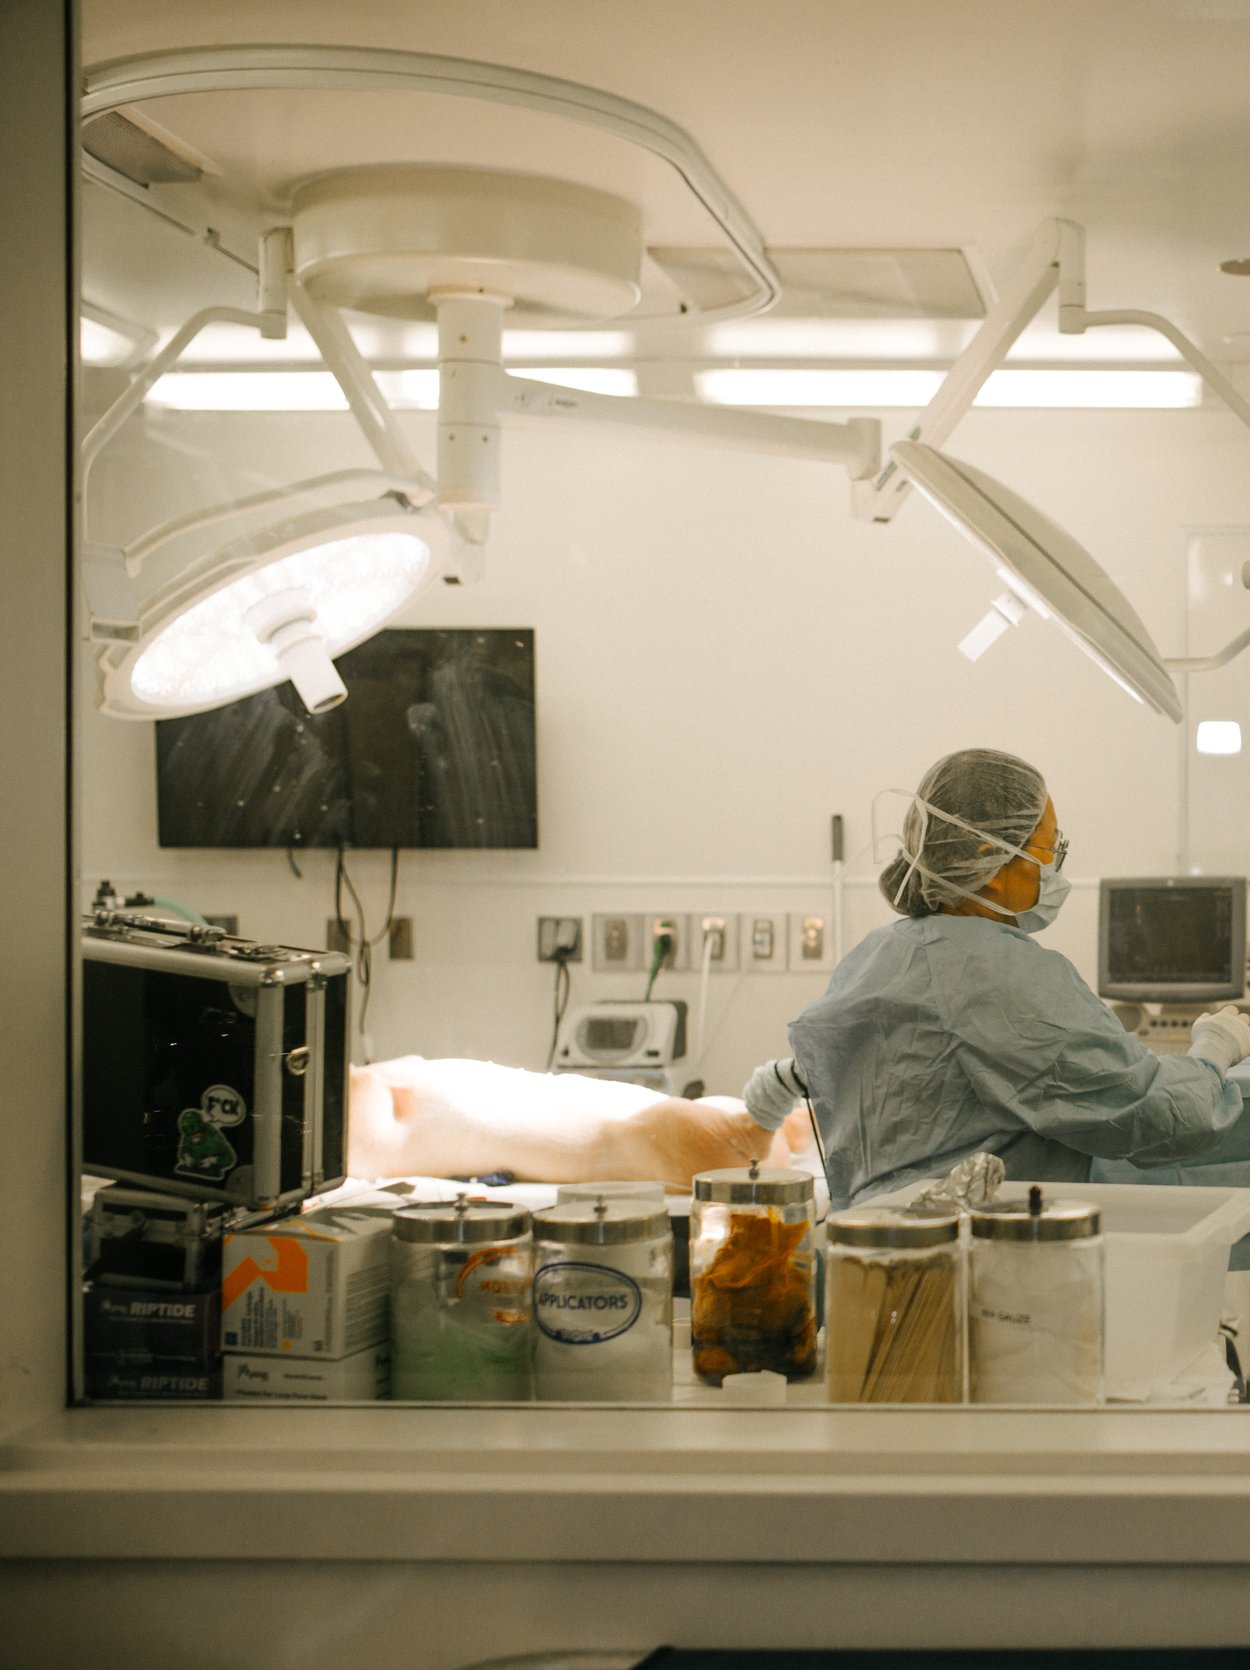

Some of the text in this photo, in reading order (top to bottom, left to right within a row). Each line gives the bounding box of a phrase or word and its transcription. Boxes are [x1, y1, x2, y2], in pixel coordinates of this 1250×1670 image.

[130, 1301, 196, 1317] RIPTIDE
[538, 1292, 628, 1310] APPLICATORS
[140, 1376, 210, 1391] RIPTIDE
